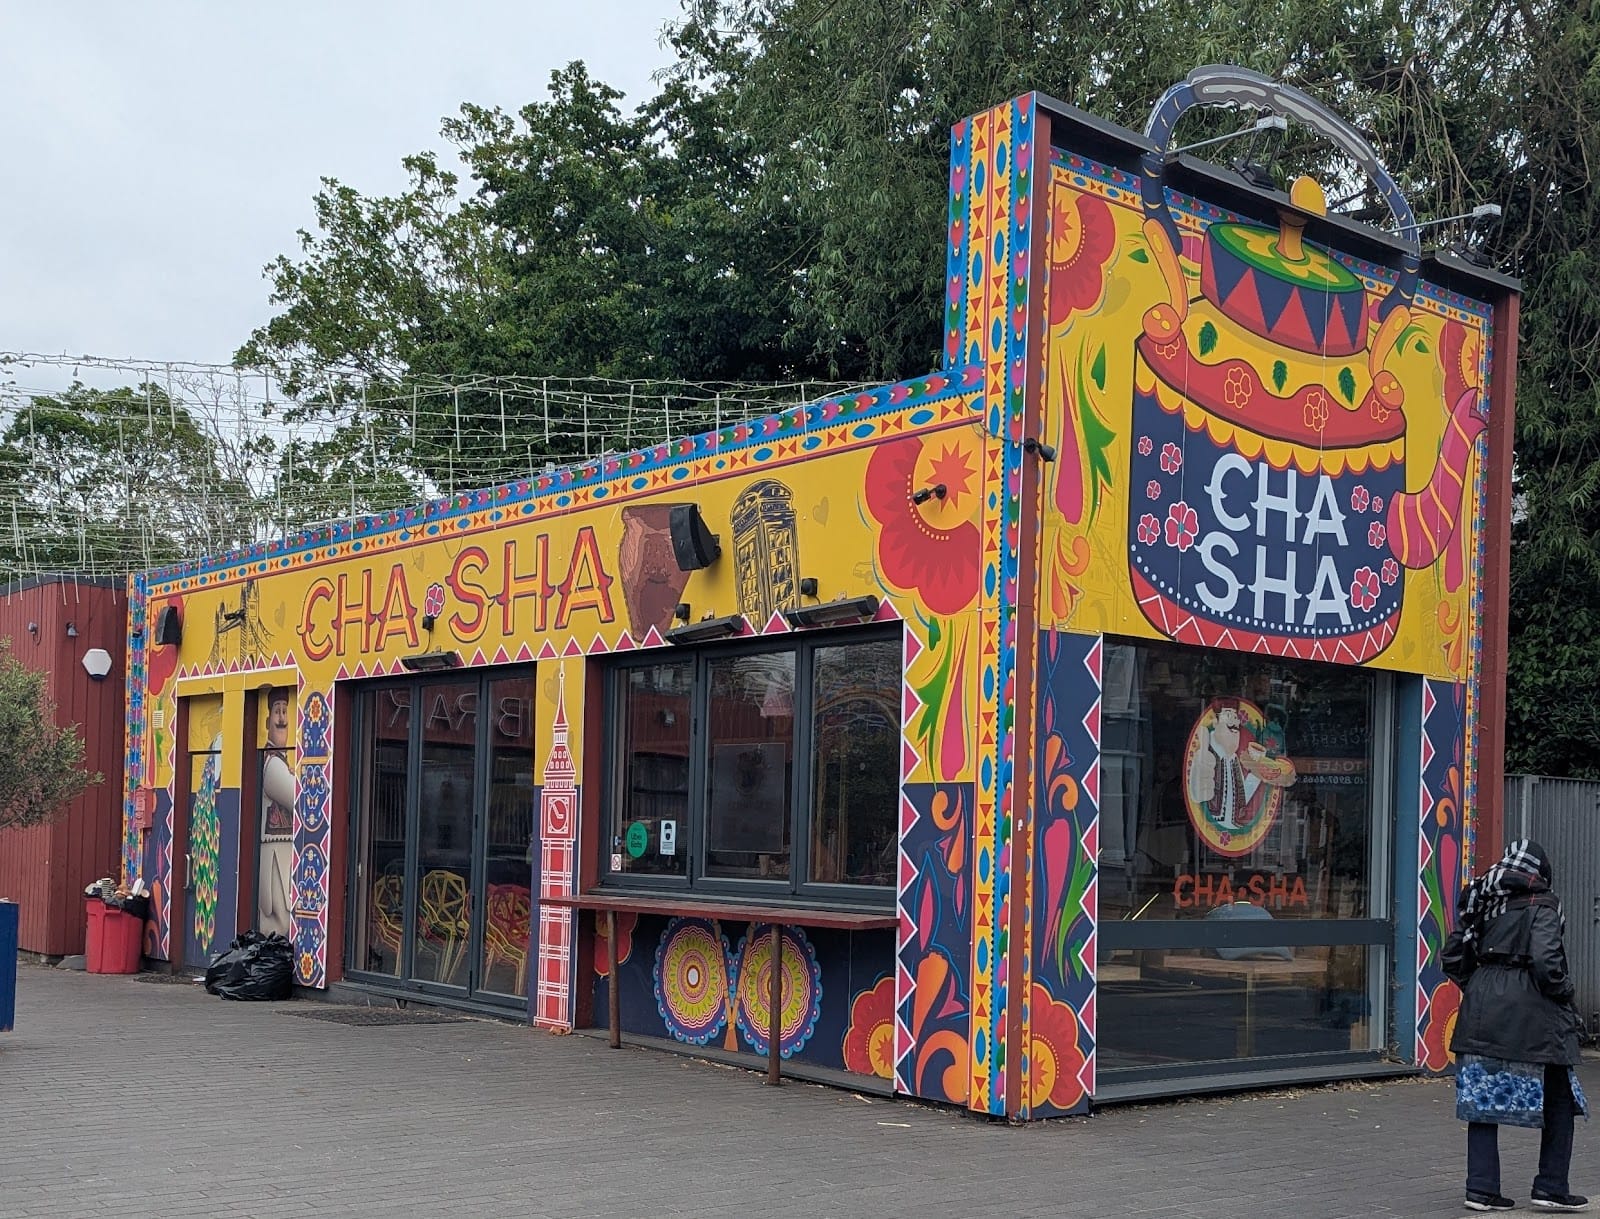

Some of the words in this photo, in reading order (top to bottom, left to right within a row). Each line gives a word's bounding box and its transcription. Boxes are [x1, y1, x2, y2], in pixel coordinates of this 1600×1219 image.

[1204, 453, 1349, 546] CHA
[296, 563, 419, 661] CHA
[445, 526, 615, 643] SHA
[1194, 531, 1352, 626] SHA
[1172, 874, 1236, 908] CHA
[1248, 875, 1309, 908] SHA
